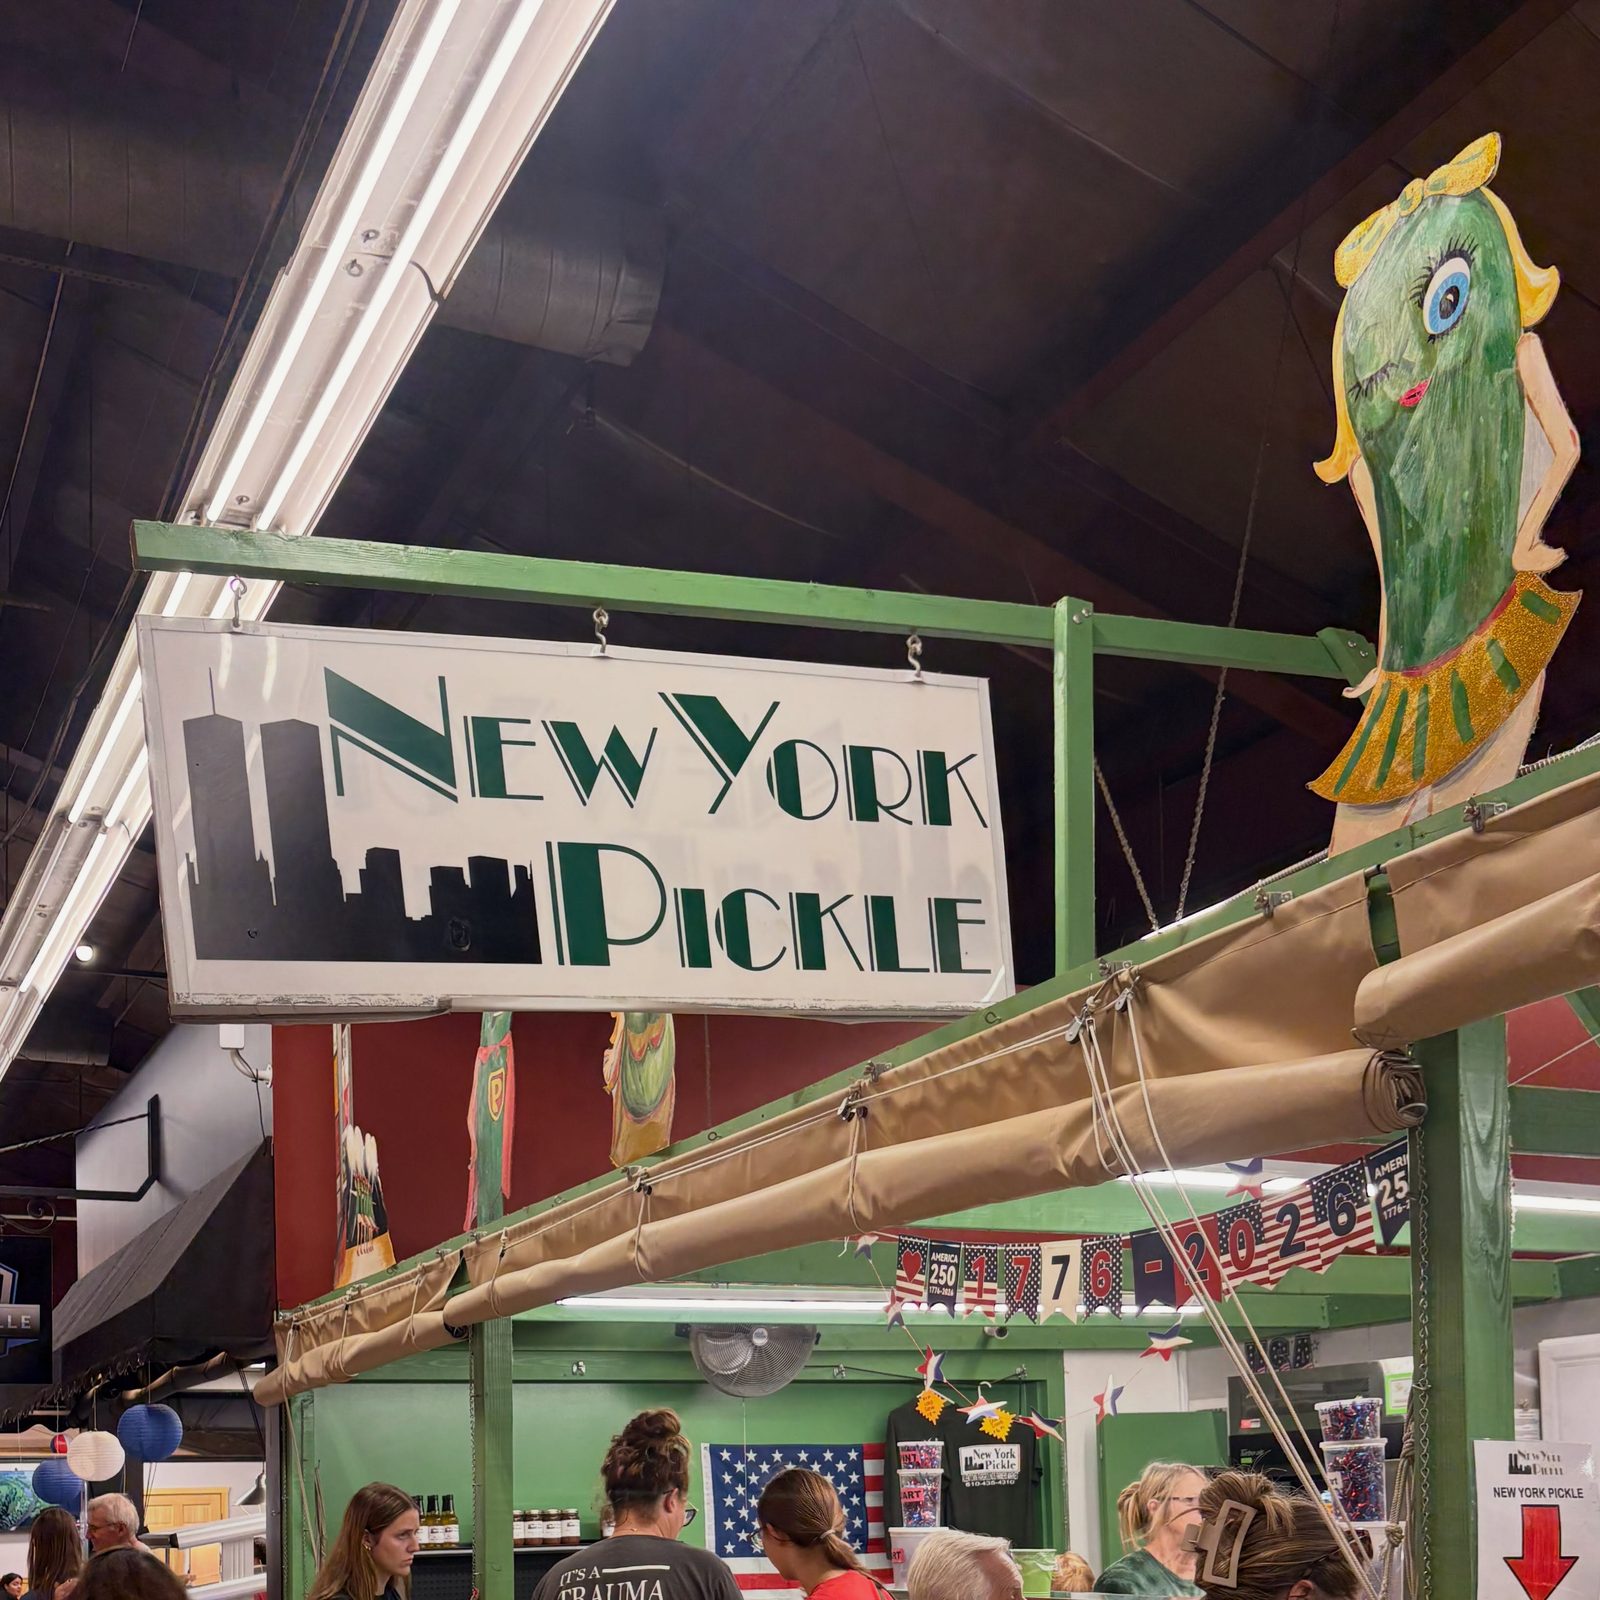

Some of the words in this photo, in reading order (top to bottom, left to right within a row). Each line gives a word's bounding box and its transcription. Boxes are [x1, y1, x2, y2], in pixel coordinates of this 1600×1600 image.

[324, 667, 658, 808] NEW
[658, 692, 988, 828] YORK
[546, 842, 991, 972] PICKLE
[491, 1078, 502, 1113] P
[1374, 1155, 1409, 1179] AMERI
[931, 1252, 958, 1263] AMERICA
[930, 1264, 956, 1286] 250
[974, 1449, 991, 1460] New
[995, 1448, 1016, 1459] York
[986, 1460, 1016, 1470] Pickle
[1493, 1487, 1516, 1498] NEW
[1518, 1487, 1546, 1498] YORK
[1548, 1488, 1584, 1499] PICKLE
[560, 1567, 586, 1587] IT'S
[589, 1566, 600, 1579] A
